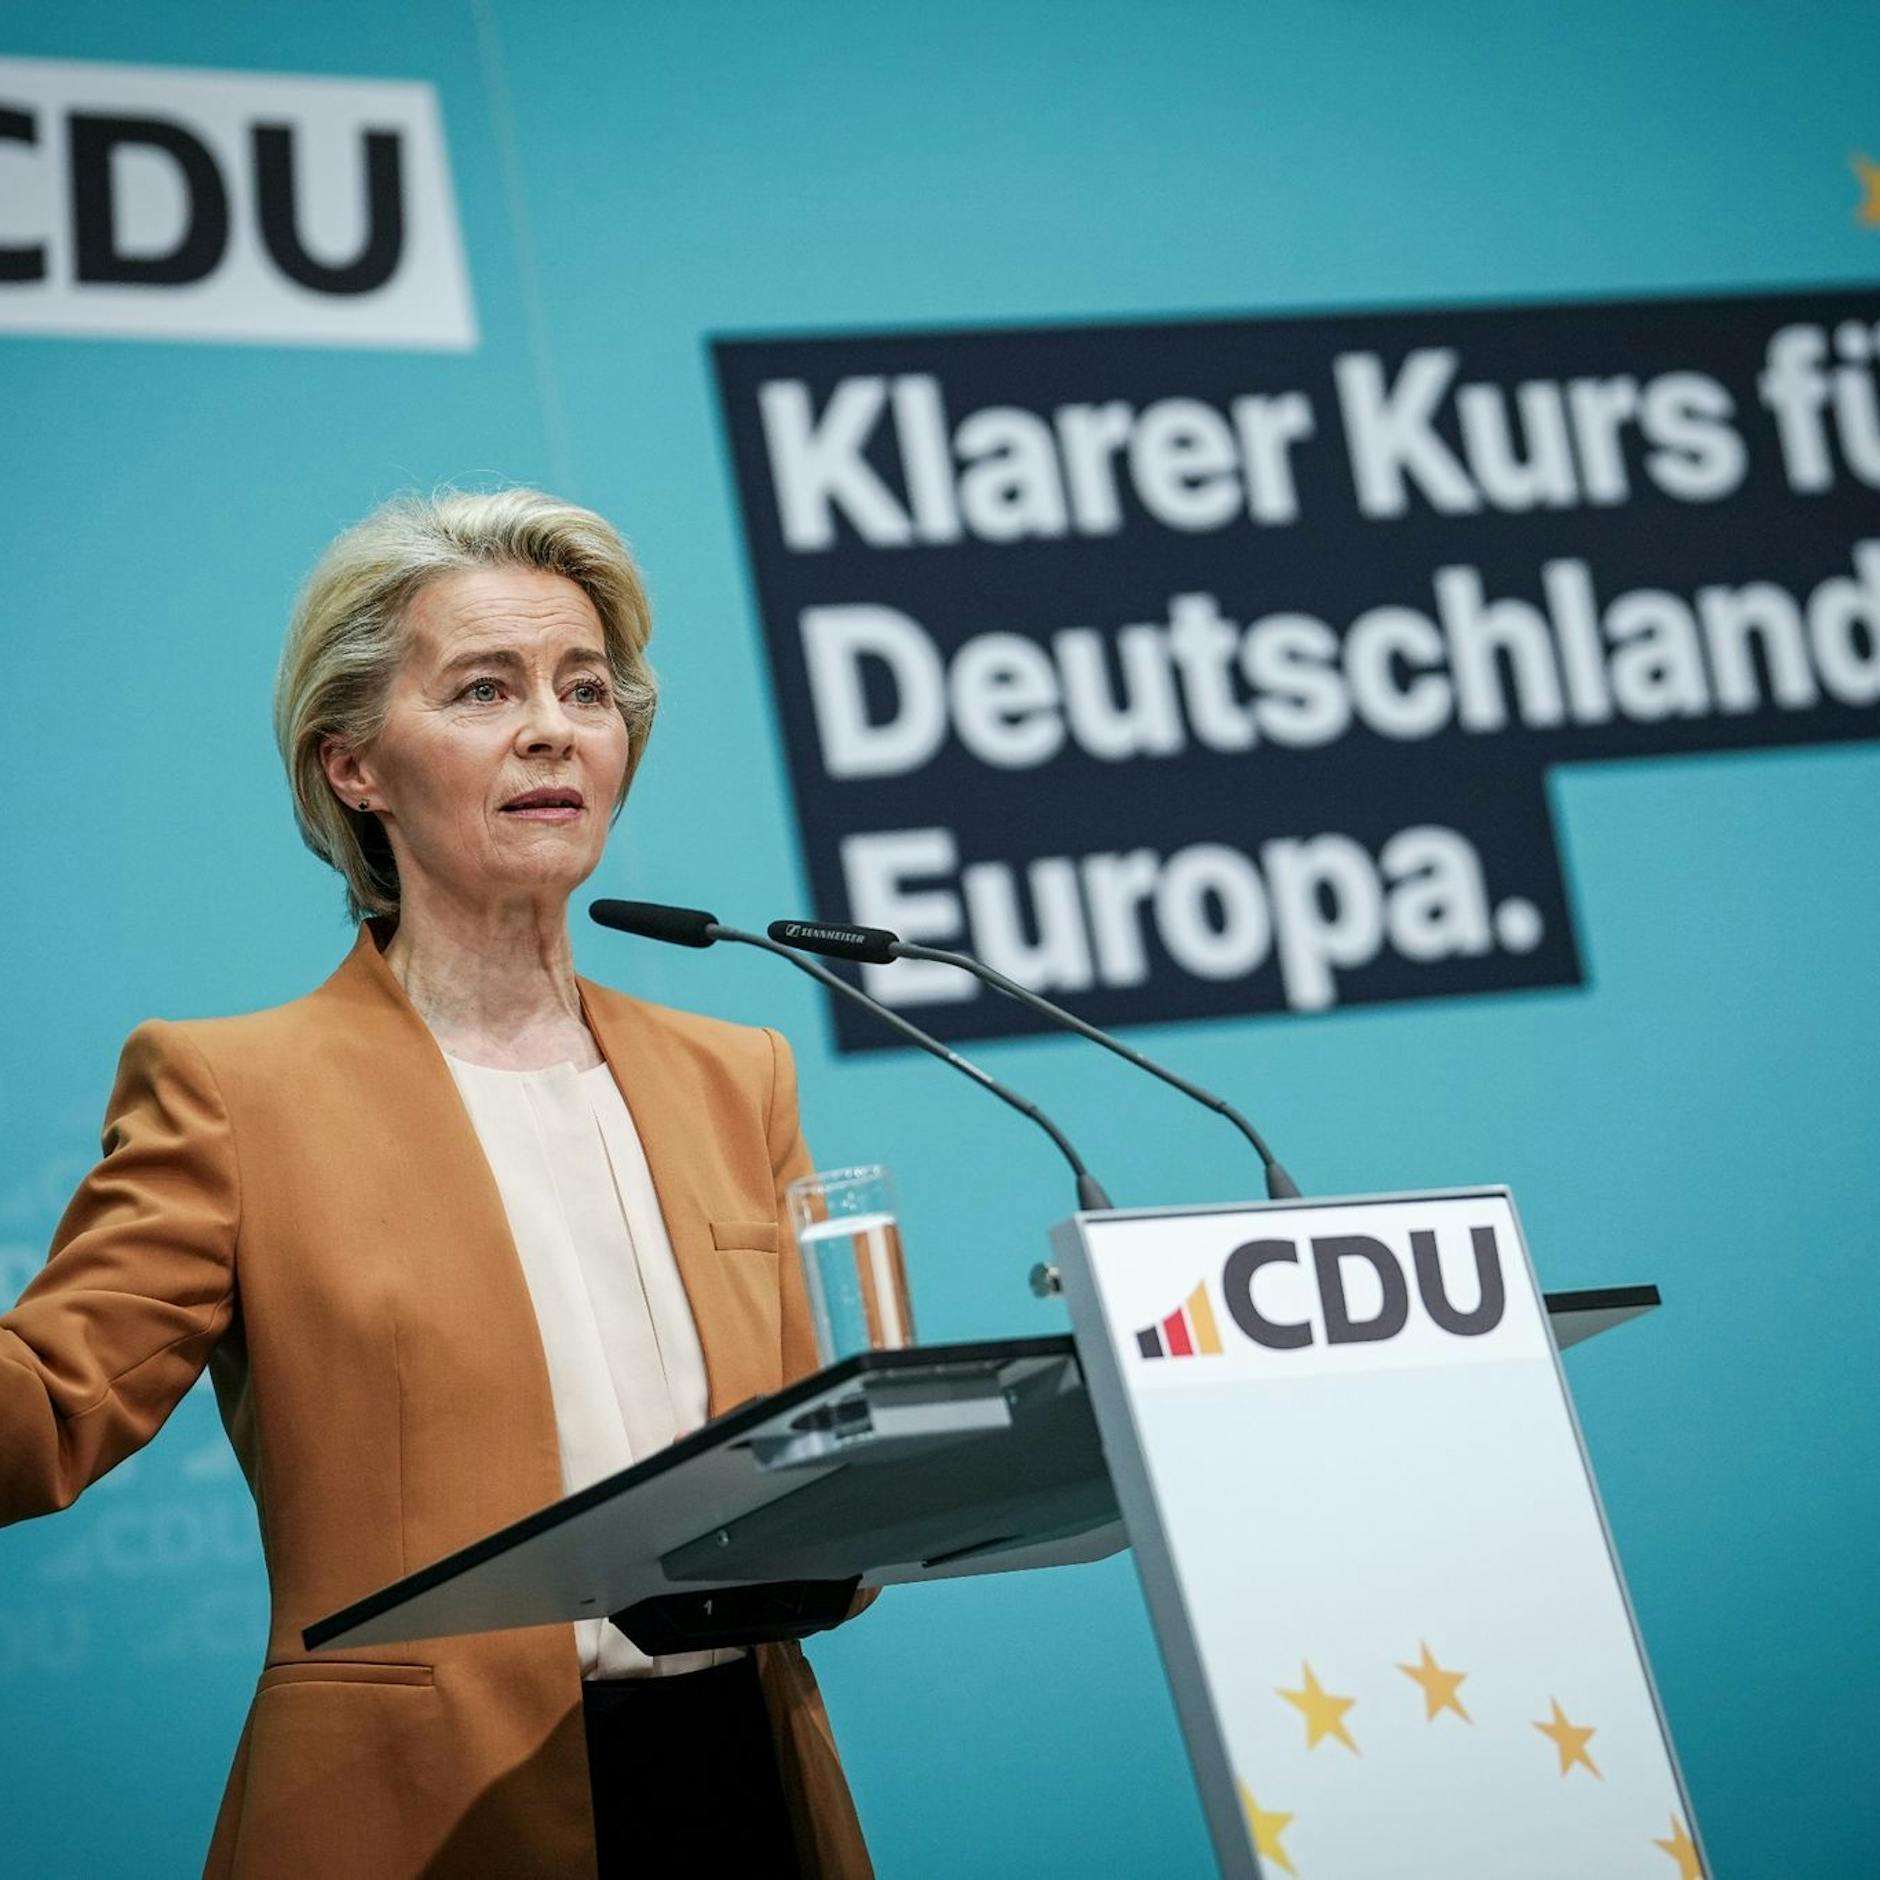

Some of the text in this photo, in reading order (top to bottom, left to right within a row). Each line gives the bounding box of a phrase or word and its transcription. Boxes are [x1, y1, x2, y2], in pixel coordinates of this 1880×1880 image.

[0, 102, 408, 298] DU
[757, 371, 1316, 554] Klarer
[1332, 347, 1748, 519] Kurs
[797, 538, 1880, 780] Deutschland
[800, 927, 866, 945] SENNHEISER
[838, 824, 1544, 1012] Europa.
[1221, 1224, 1507, 1352] CDU
